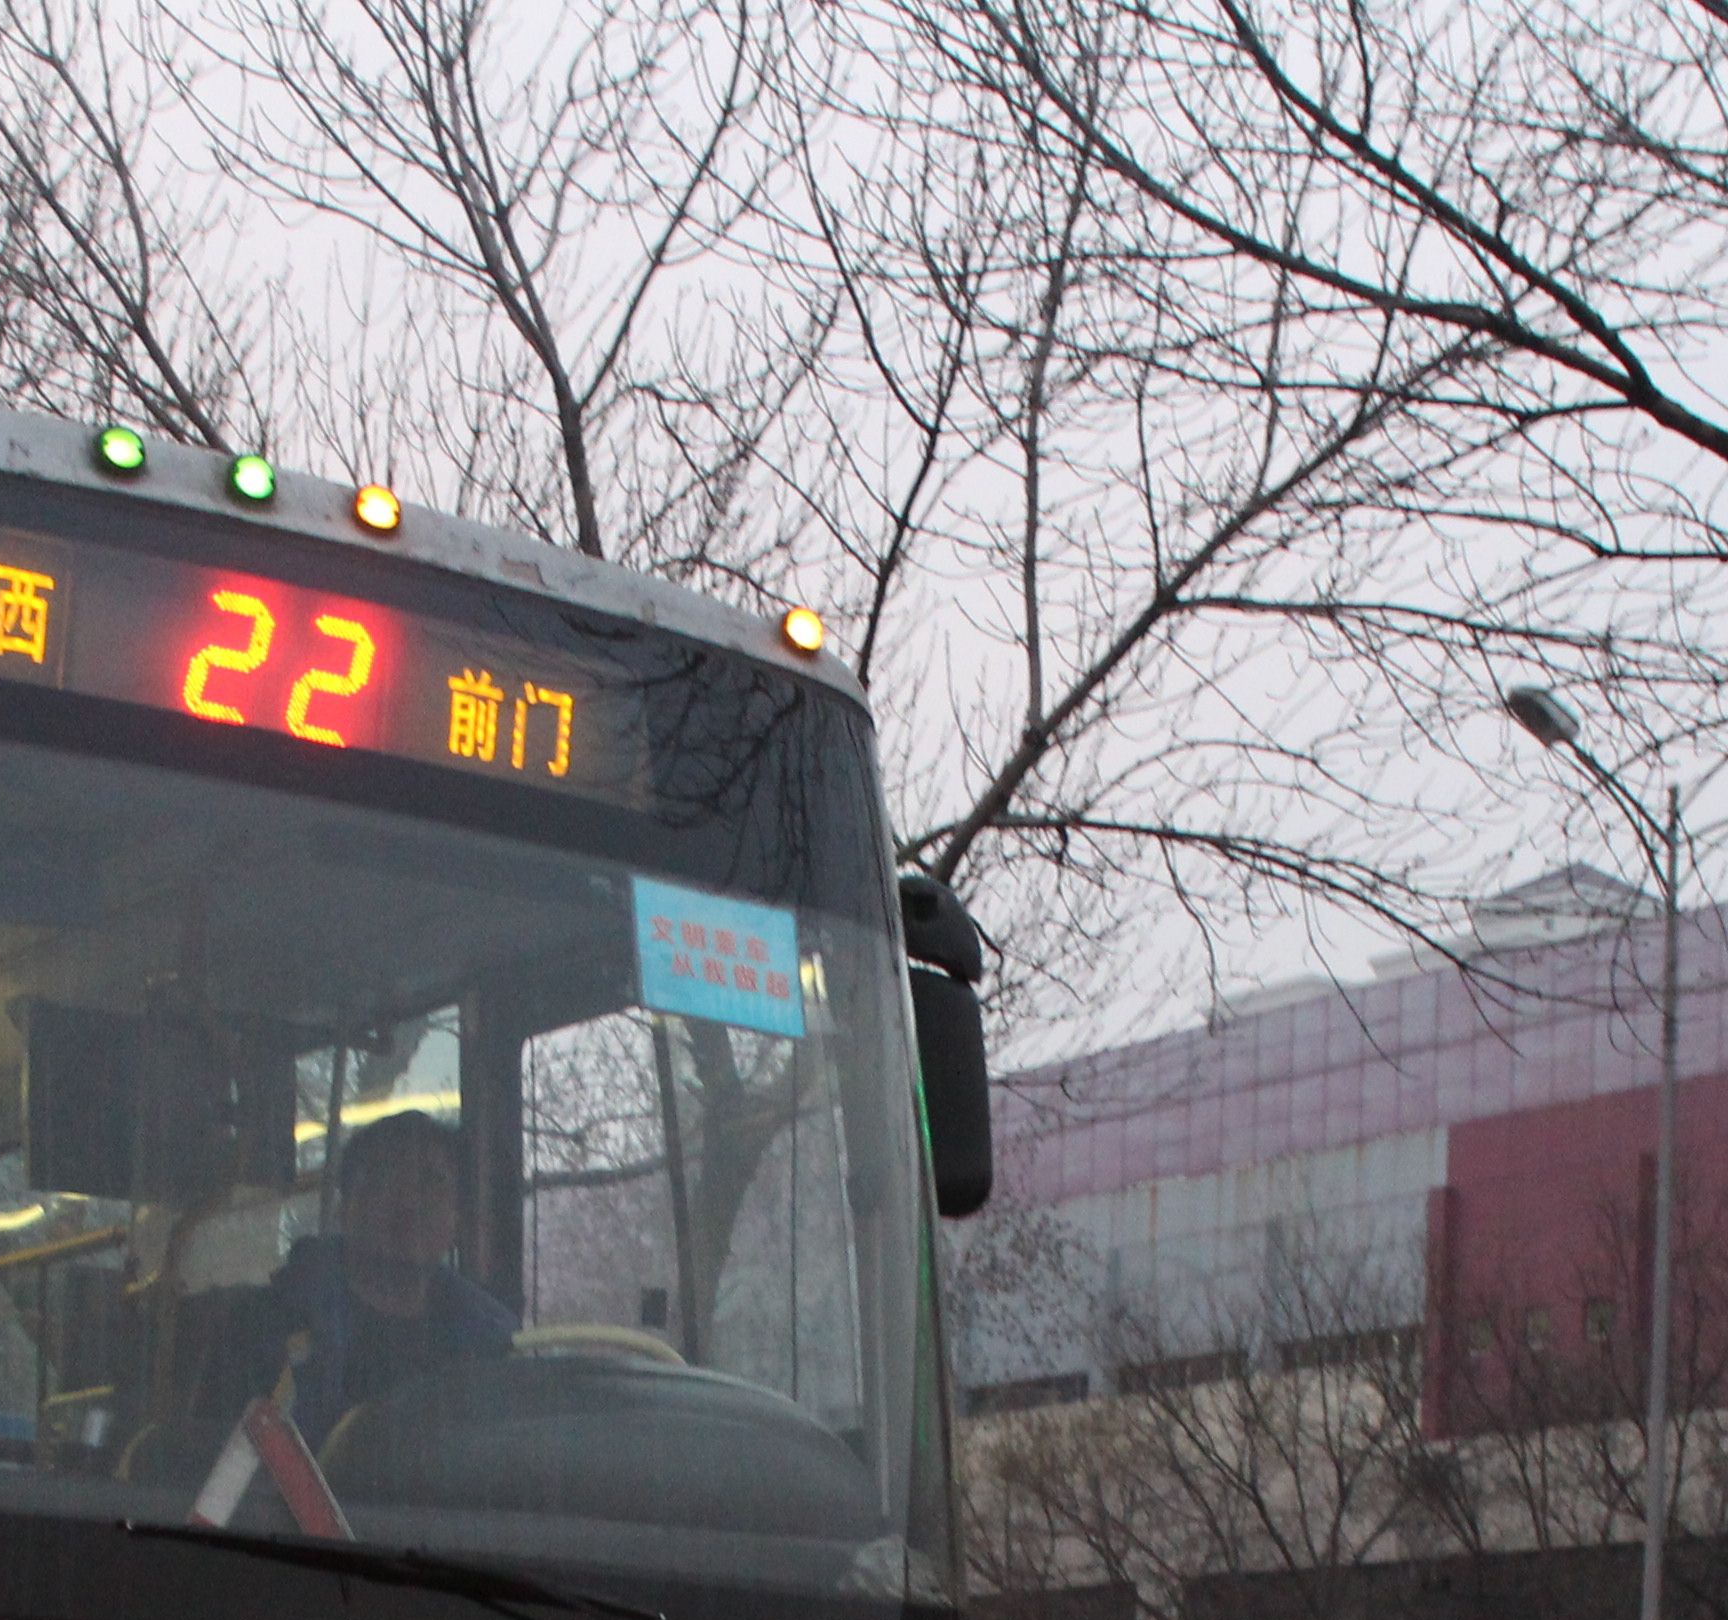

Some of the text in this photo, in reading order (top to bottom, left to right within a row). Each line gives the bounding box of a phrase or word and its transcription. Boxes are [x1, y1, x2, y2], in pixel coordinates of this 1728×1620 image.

[182, 588, 376, 748] 22
[446, 668, 575, 777] 前门
[672, 953, 792, 999] 从我做起
